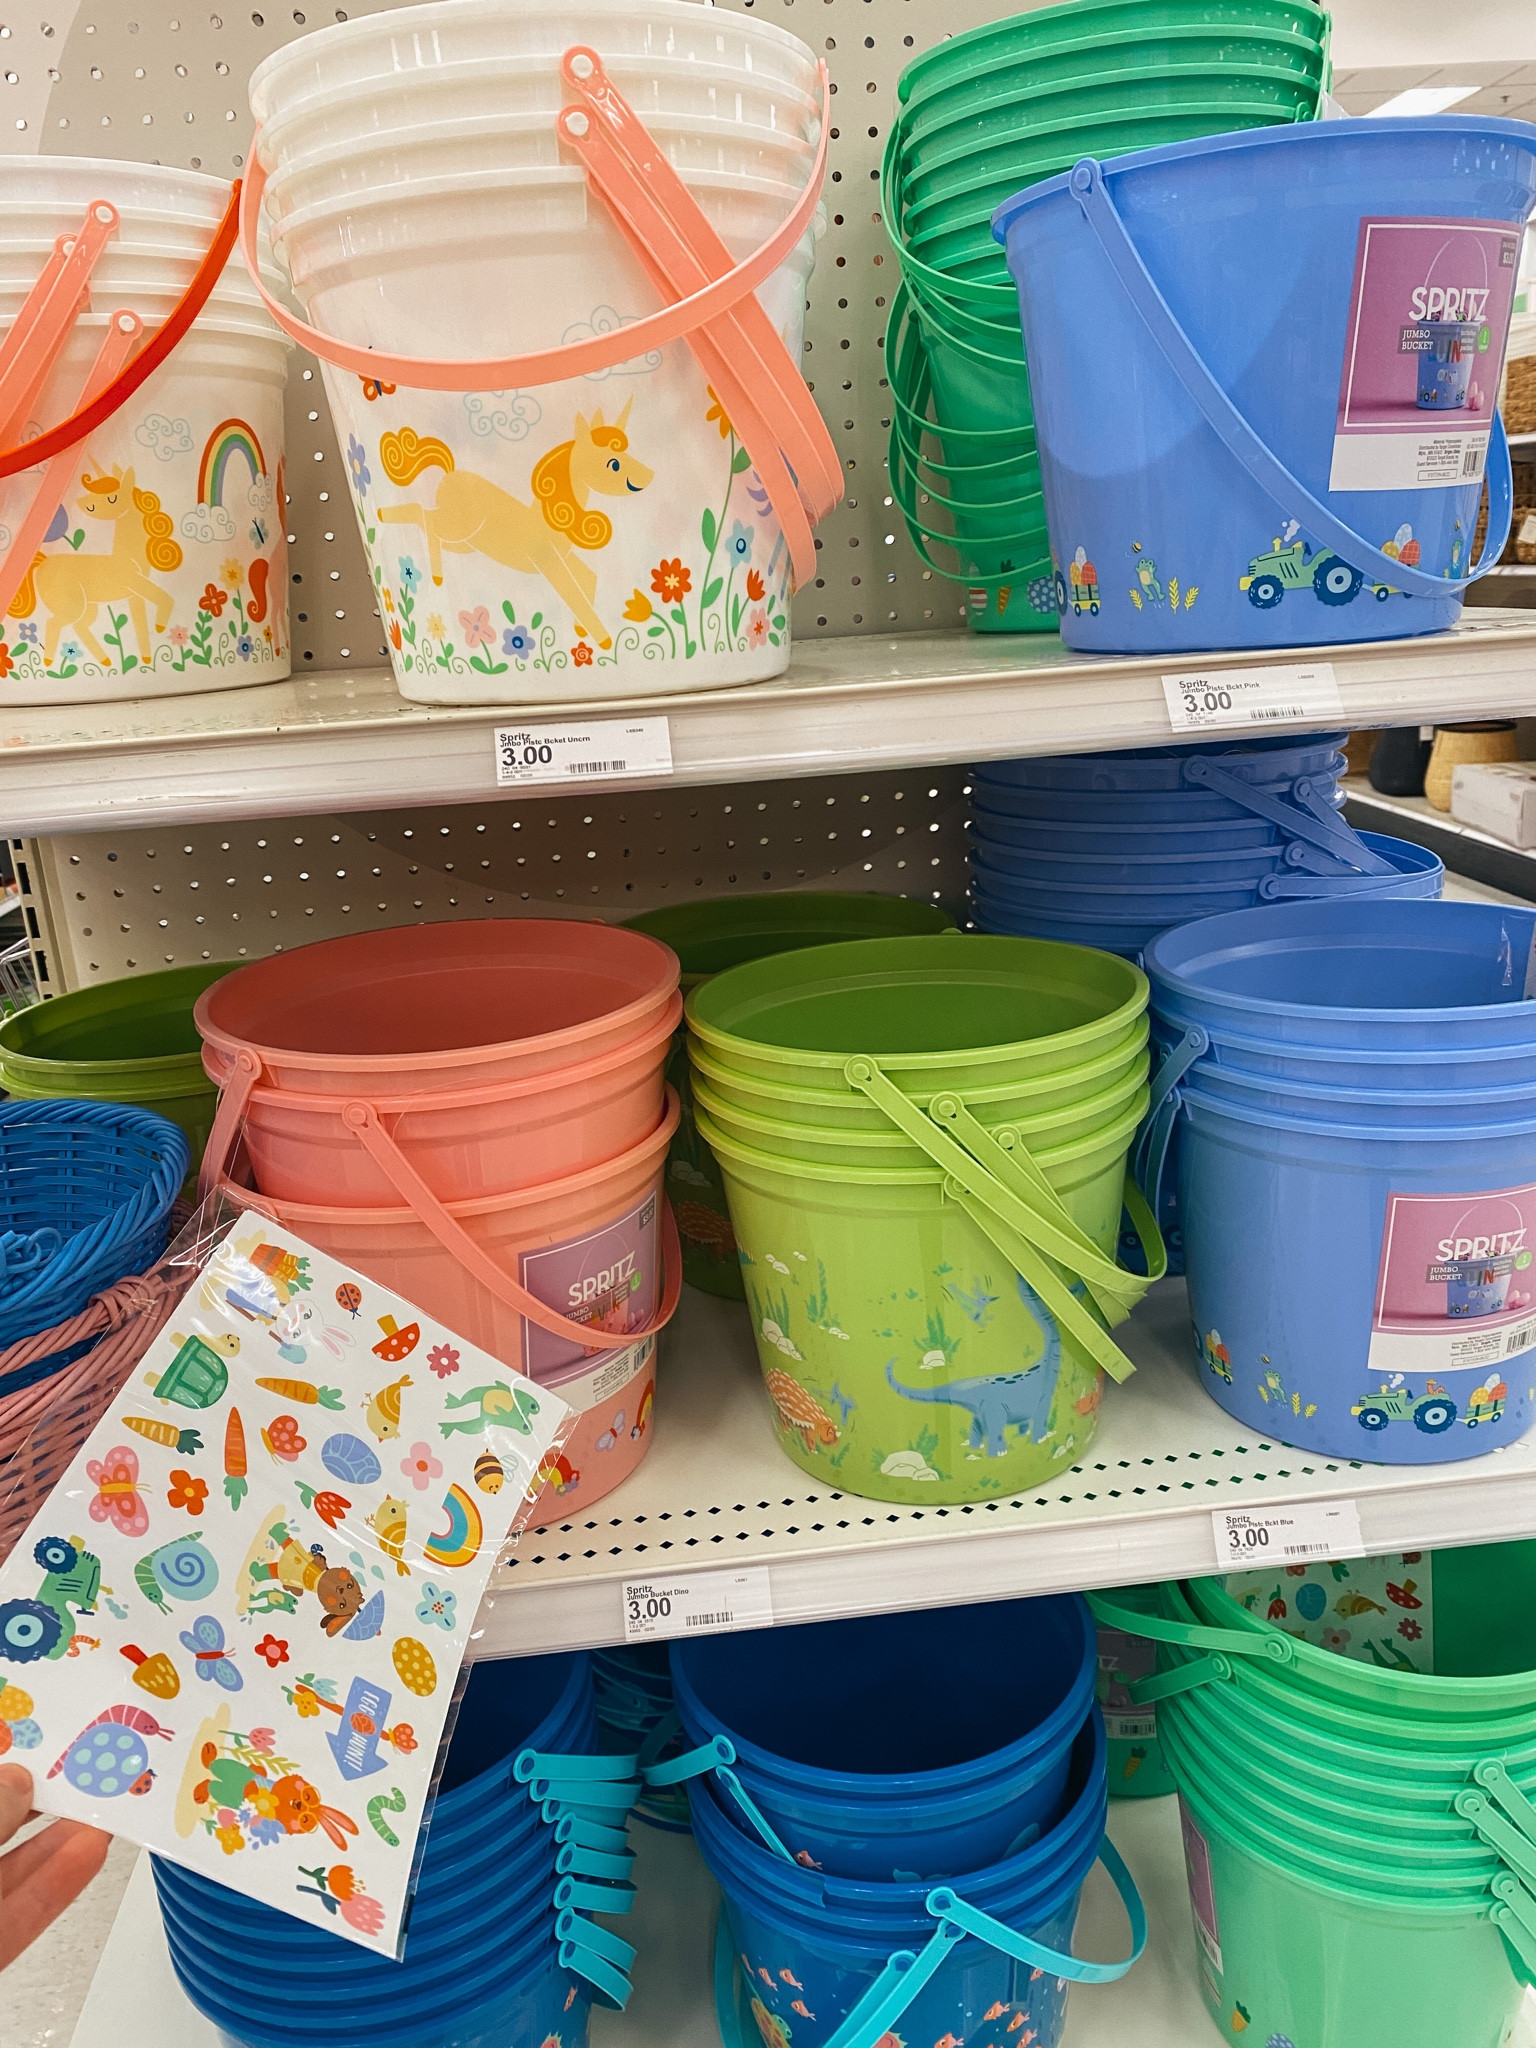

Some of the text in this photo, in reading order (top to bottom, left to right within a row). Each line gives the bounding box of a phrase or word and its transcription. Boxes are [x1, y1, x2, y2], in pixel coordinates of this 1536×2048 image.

[1408, 286, 1490, 322] SPRITZ
[1402, 329, 1431, 340] JUMBO
[1402, 341, 1433, 350] BUCKET
[1179, 680, 1208, 690] Spritz
[1183, 691, 1232, 712] 3.00
[500, 733, 531, 743] Spritz
[523, 738, 542, 746] Plstc
[502, 745, 552, 766] 3.00
[1435, 1227, 1528, 1262] SPRITZ
[568, 1250, 638, 1306] SPRITZ
[1429, 1273, 1463, 1281] BUCKET
[574, 1312, 593, 1323] CKET
[1225, 1515, 1250, 1525] Spritz
[1229, 1527, 1269, 1548] 3.00
[626, 1585, 652, 1595] Spritz
[629, 1597, 671, 1620] 3.00
[343, 1690, 380, 1772] EGG HUNT!
